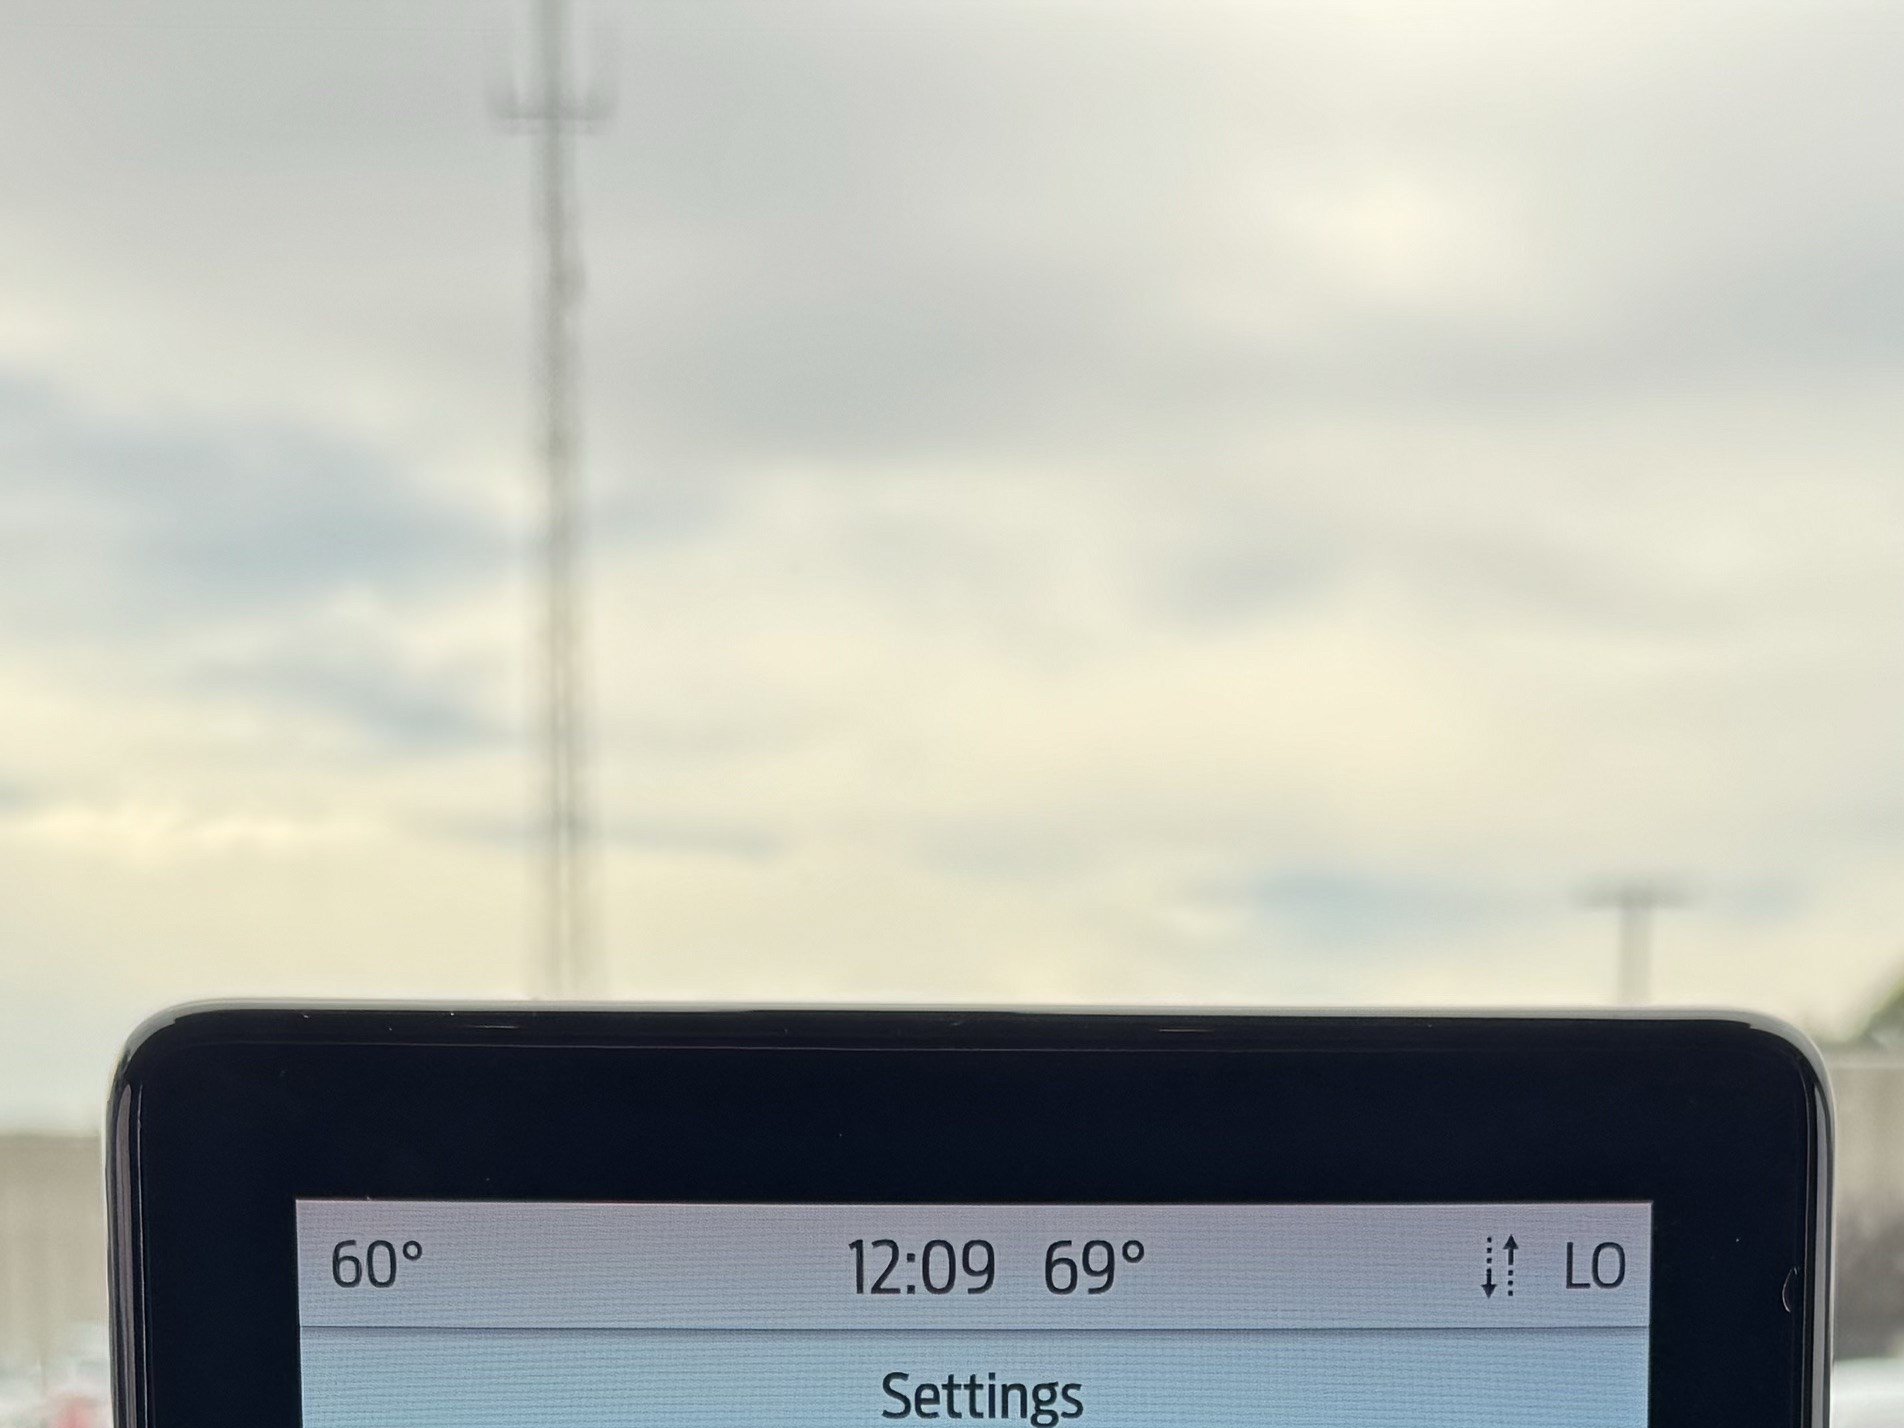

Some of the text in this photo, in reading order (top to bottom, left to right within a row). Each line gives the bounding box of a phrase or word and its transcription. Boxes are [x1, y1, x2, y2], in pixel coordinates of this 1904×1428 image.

[332, 1239, 423, 1288] 60°
[848, 1238, 1145, 1295] 12:09 69°
[1566, 1241, 1626, 1289] LO
[882, 1371, 1084, 1428] Settings
